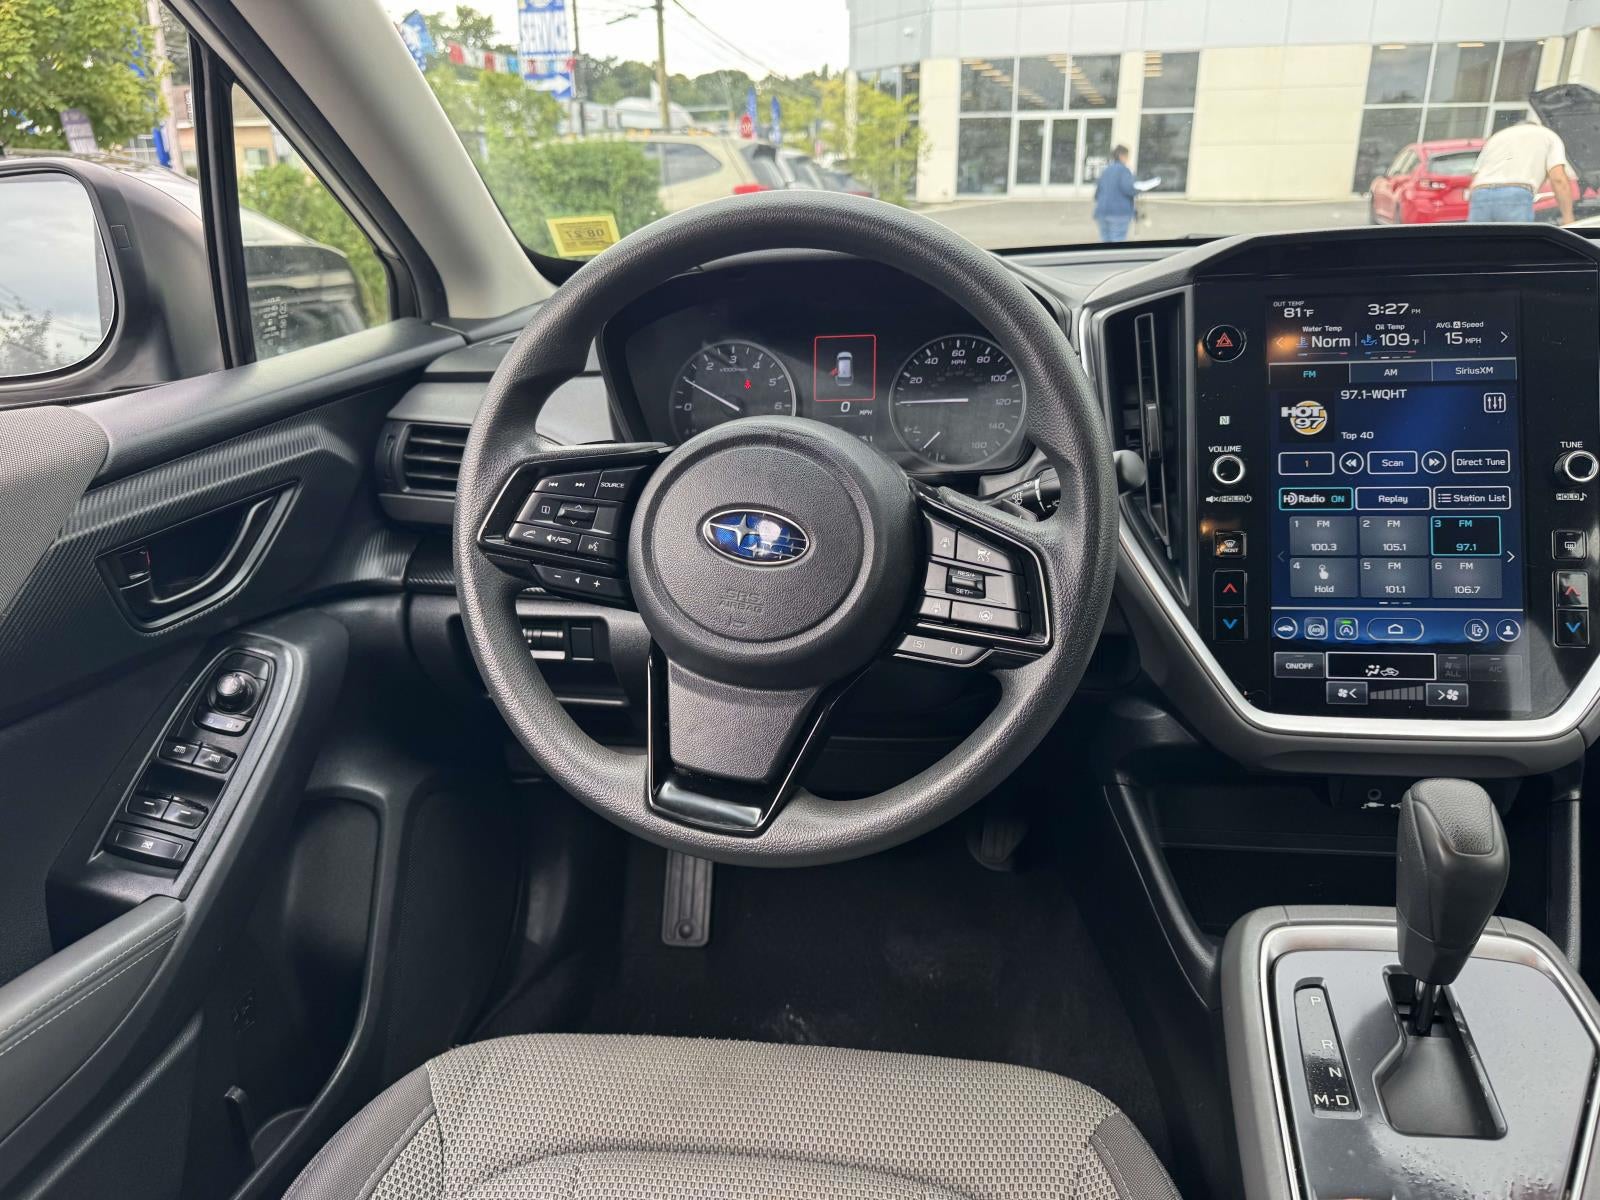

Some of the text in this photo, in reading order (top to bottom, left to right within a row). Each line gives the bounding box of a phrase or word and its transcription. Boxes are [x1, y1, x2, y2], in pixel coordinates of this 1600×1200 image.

[1368, 303, 1409, 316] 3:27
[1325, 325, 1342, 333] Temp
[1388, 323, 1405, 331] Temp
[1462, 321, 1484, 329] Speed
[1311, 336, 1351, 348] Norm
[1445, 332, 1463, 345] 15
[951, 349, 966, 357] 60
[729, 355, 737, 364] 3
[924, 357, 939, 365] 40
[976, 355, 991, 364] 80
[705, 362, 714, 371] 2
[1303, 370, 1316, 378] FM
[1455, 367, 1494, 375] SiriusXM
[909, 376, 923, 384] 20
[990, 374, 1008, 382] 100
[768, 378, 777, 387] 5
[1340, 389, 1407, 400] 97.1-WQHT
[683, 402, 692, 412] 0
[774, 401, 783, 410] 6
[840, 401, 851, 413] 0
[1281, 406, 1324, 418] HOT
[1295, 417, 1325, 429] 97
[1341, 432, 1357, 440] Top
[1381, 459, 1404, 467] Scan
[1456, 458, 1506, 466] Direct Tune
[1330, 495, 1345, 503] ON
[1378, 495, 1408, 504] Replay
[1453, 494, 1506, 503] Station List
[1294, 520, 1299, 528] 1
[1316, 520, 1330, 528] FM
[1362, 520, 1371, 528] 2
[1386, 520, 1400, 528] FM
[1434, 520, 1442, 528] 3
[1458, 520, 1473, 528] FM
[1310, 543, 1337, 551] 100.3
[1382, 543, 1407, 551] 105.1
[1455, 543, 1477, 551] 97.1
[1293, 562, 1300, 570] 4
[1363, 562, 1371, 570] 5
[1387, 562, 1401, 570] FM
[1434, 562, 1442, 570] 6
[1459, 562, 1474, 570] FM
[1314, 585, 1335, 593] Hold
[1384, 585, 1406, 593] 101.1
[1453, 586, 1481, 594] 106.7
[1285, 662, 1314, 670] ON/OFF
[1310, 996, 1321, 1006] P
[1321, 1039, 1334, 1050] R
[1328, 1067, 1342, 1078] N
